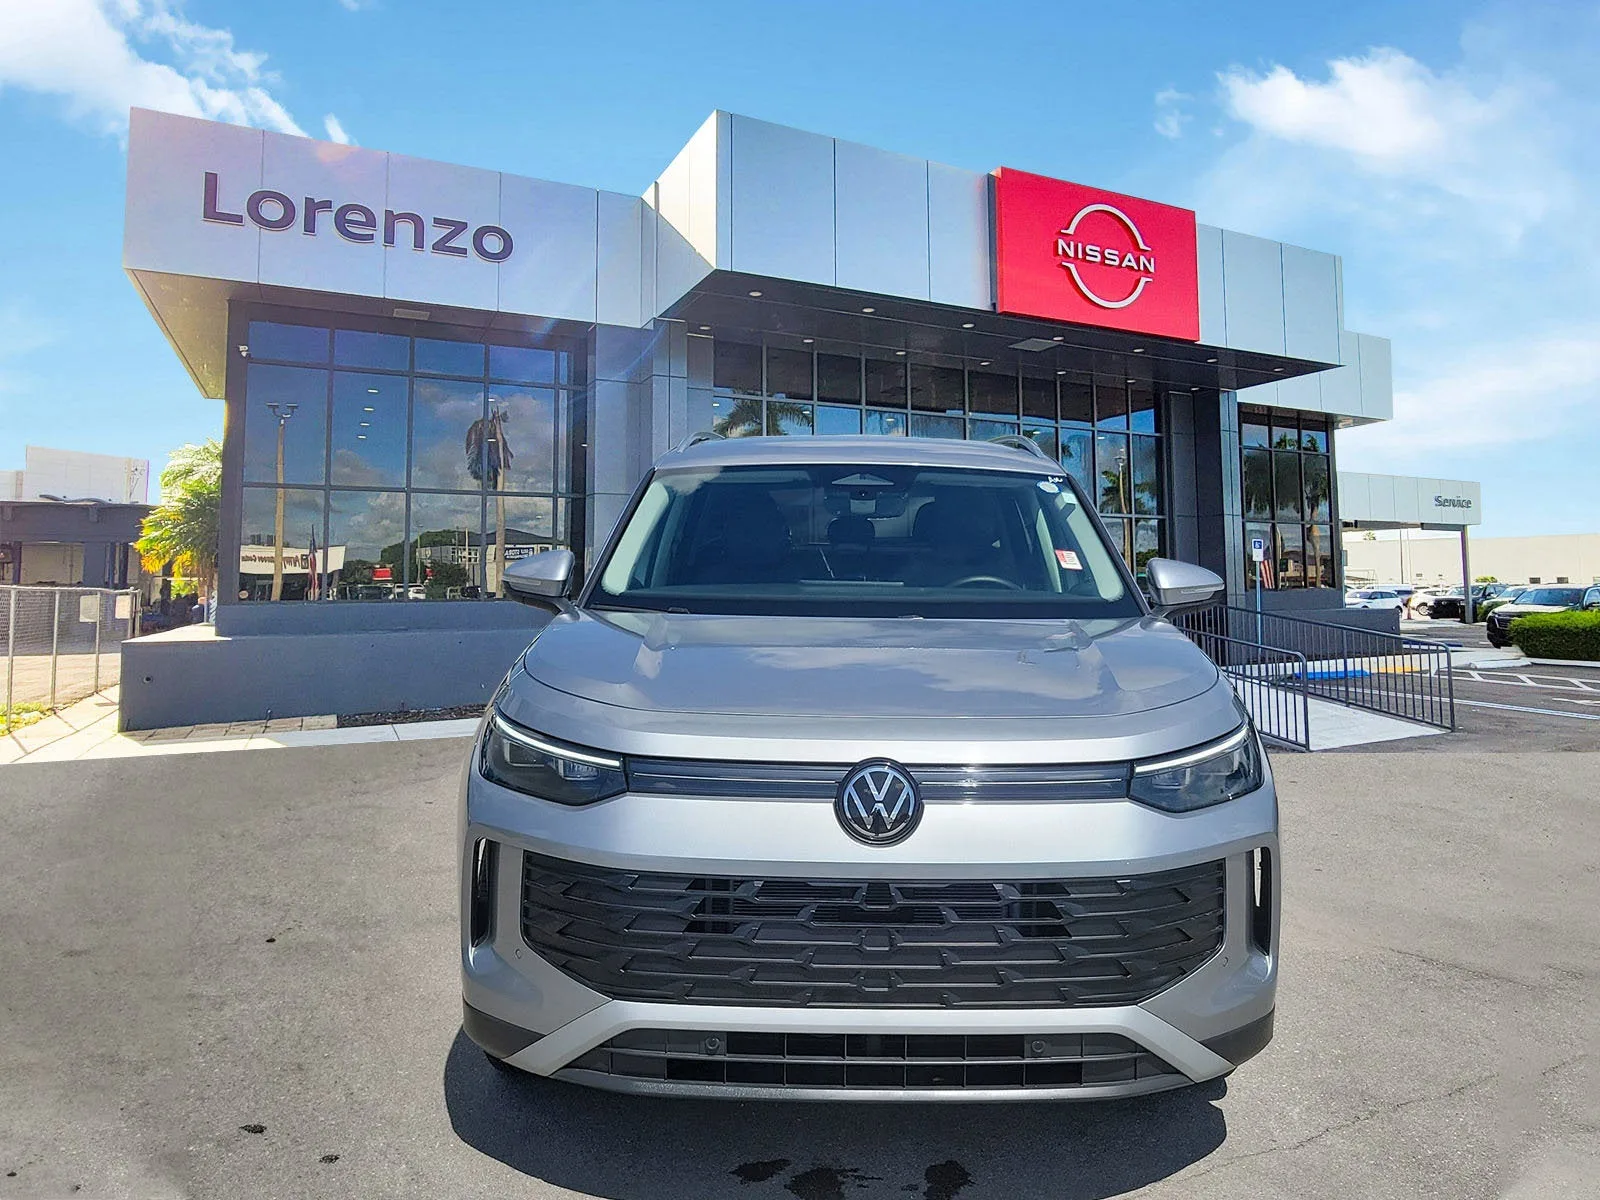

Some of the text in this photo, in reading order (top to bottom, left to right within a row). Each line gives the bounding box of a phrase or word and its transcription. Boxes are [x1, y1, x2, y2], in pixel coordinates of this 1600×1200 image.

[202, 171, 514, 263] Lorenzo
[1057, 238, 1155, 273] NISSAN
[1434, 495, 1472, 509] Service
